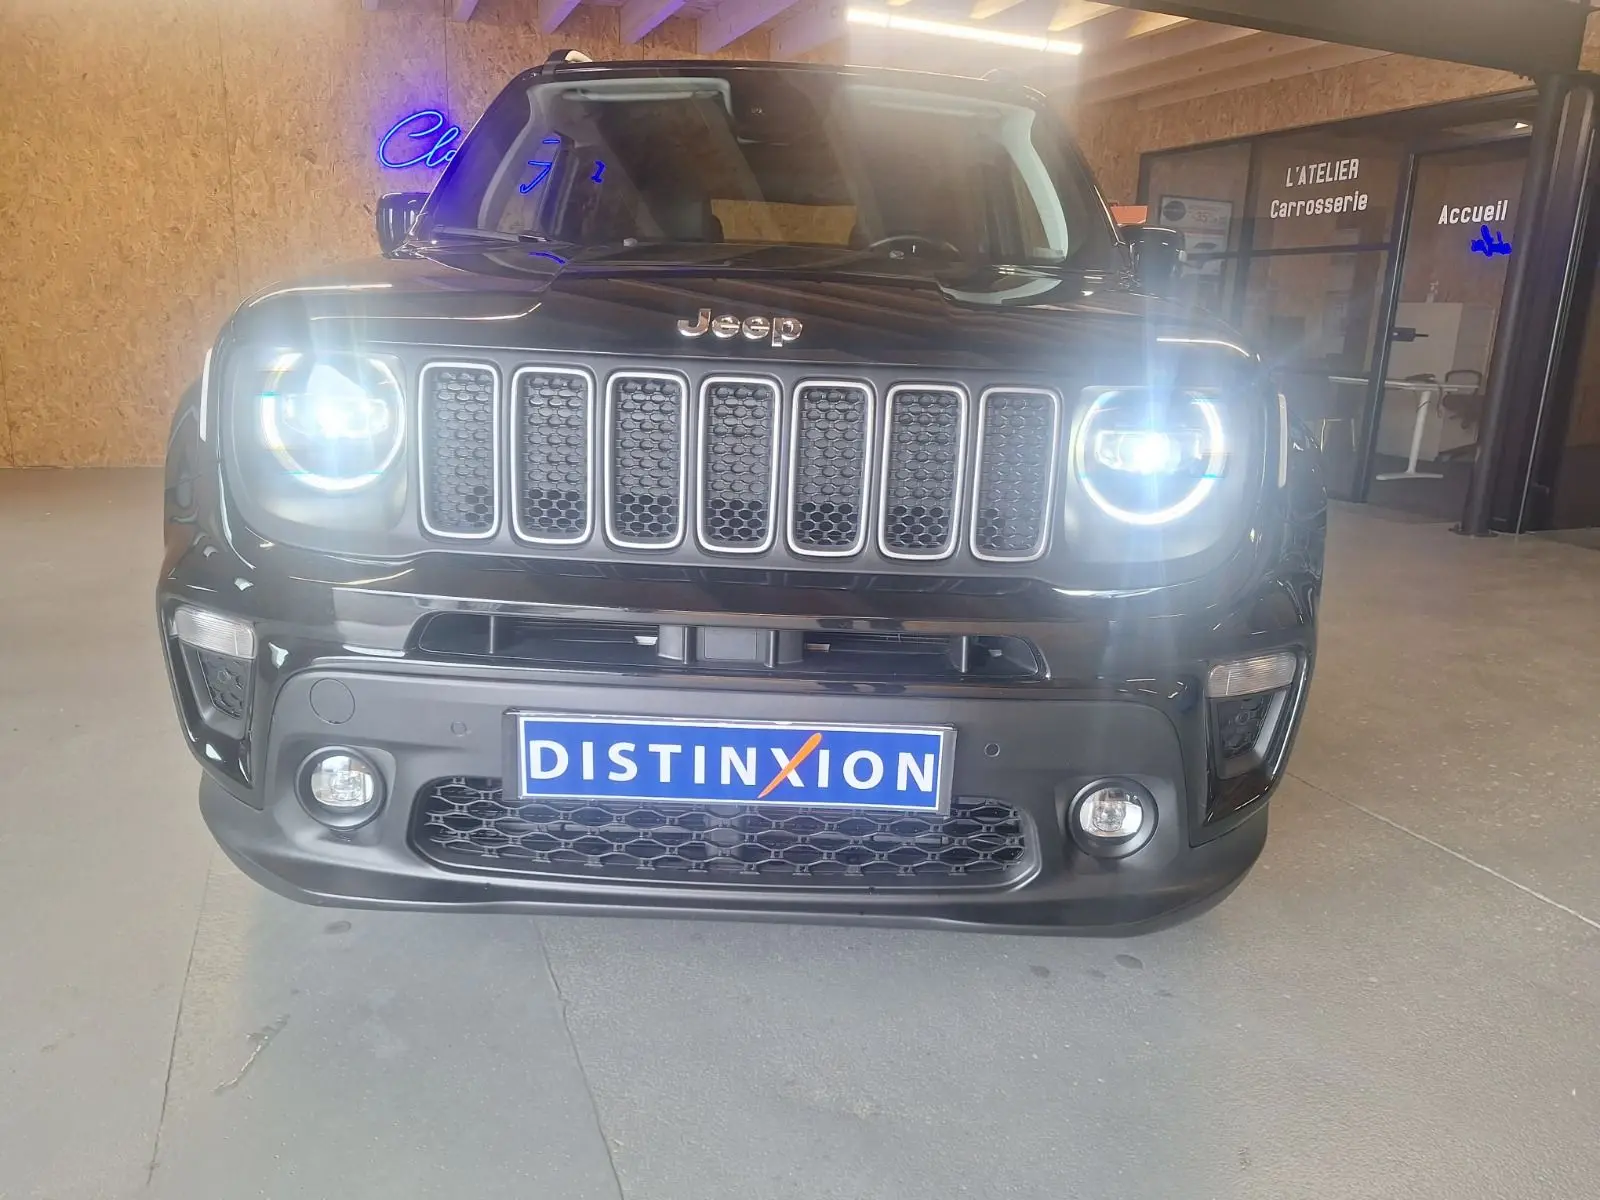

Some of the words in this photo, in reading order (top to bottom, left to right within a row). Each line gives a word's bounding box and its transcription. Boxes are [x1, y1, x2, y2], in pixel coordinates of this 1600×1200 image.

[1285, 158, 1360, 188] L'ATELIER
[1270, 190, 1368, 219] Carrosserie
[1437, 199, 1509, 225] Accueil
[677, 308, 803, 347] Jeep
[528, 732, 936, 798] DISTINXION
